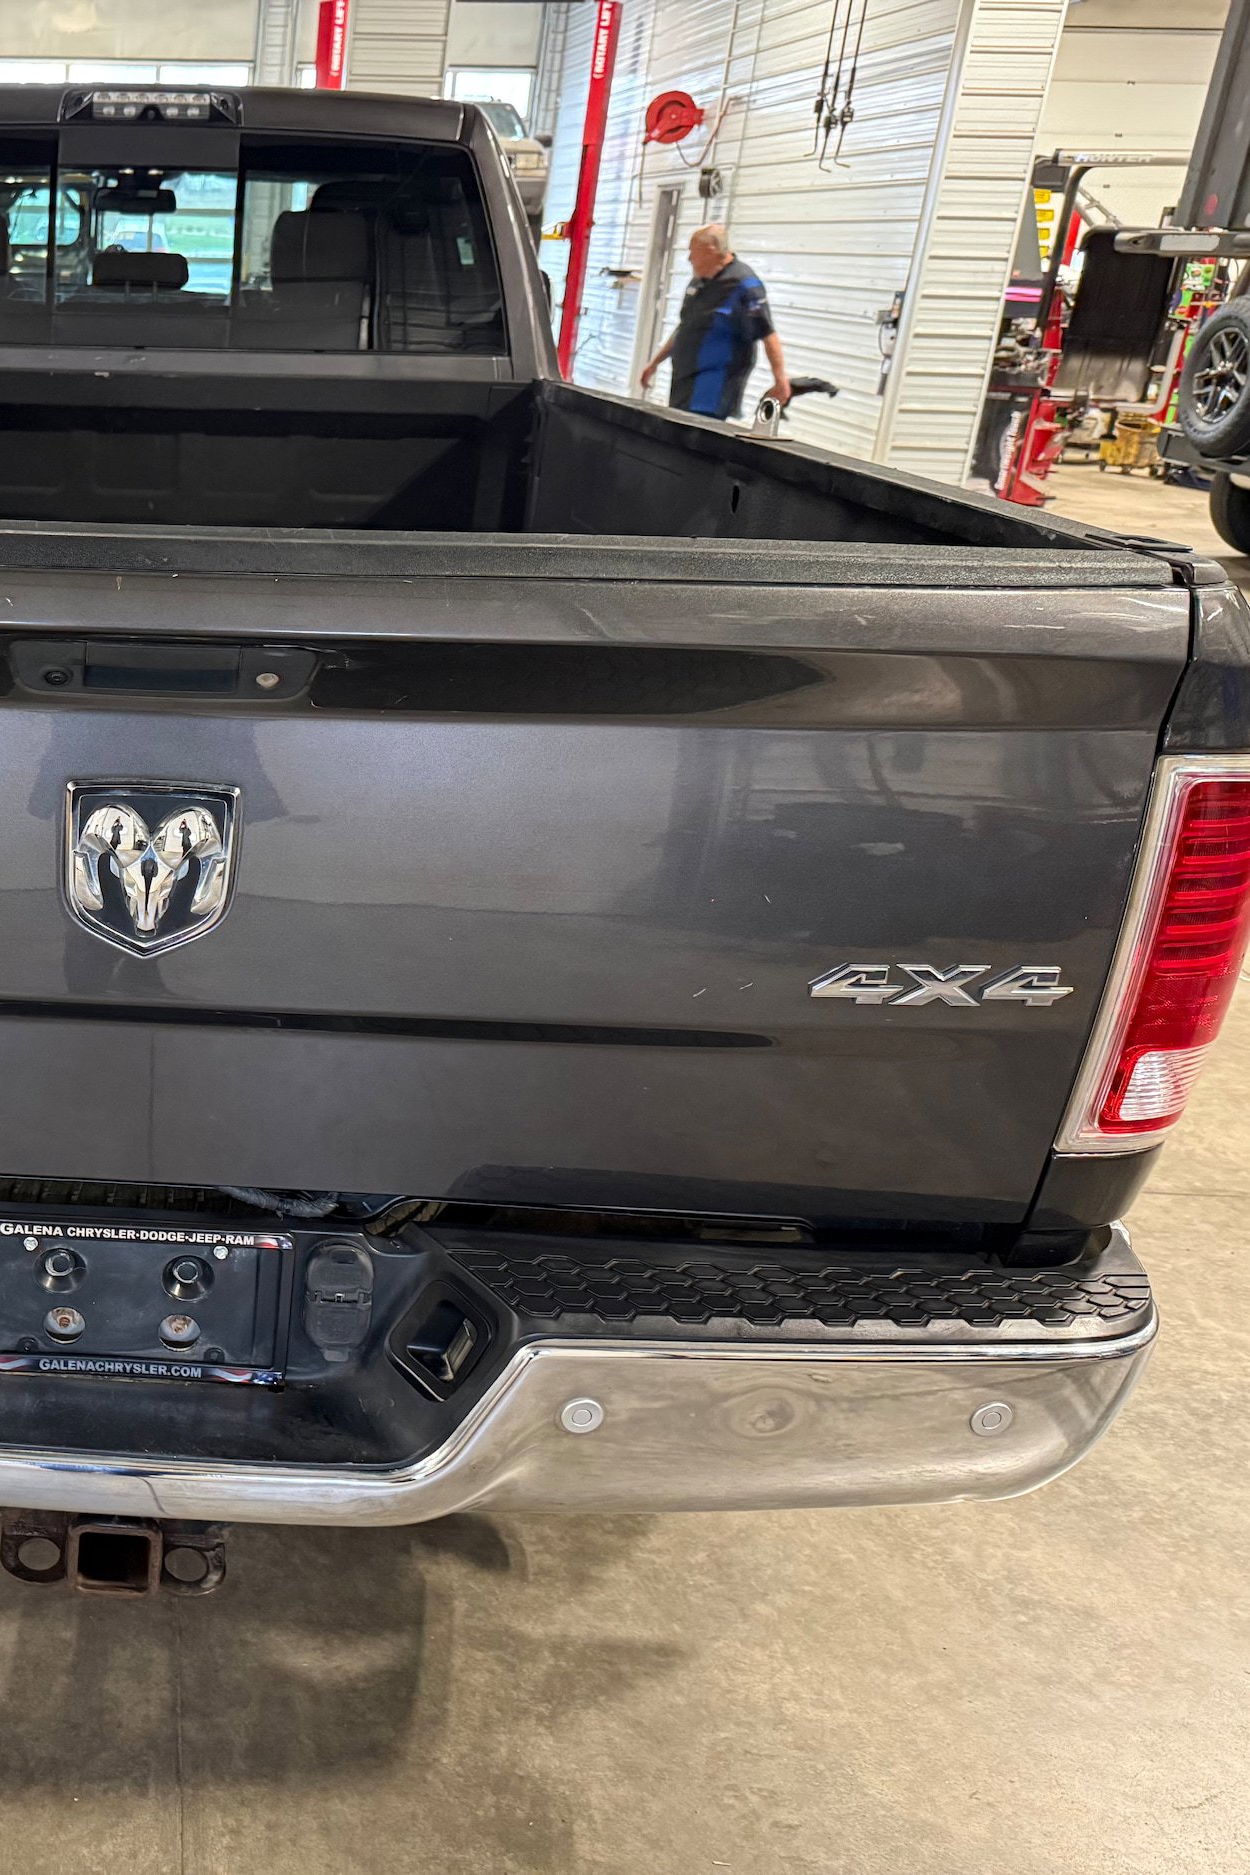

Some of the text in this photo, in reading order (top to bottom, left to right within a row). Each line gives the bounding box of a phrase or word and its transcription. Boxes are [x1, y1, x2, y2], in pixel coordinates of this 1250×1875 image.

[594, 2, 612, 73] ROTARY LIFT
[0, 1222, 63, 1236] GALENA
[39, 1358, 202, 1378] GALENACHRYSLER.COM
